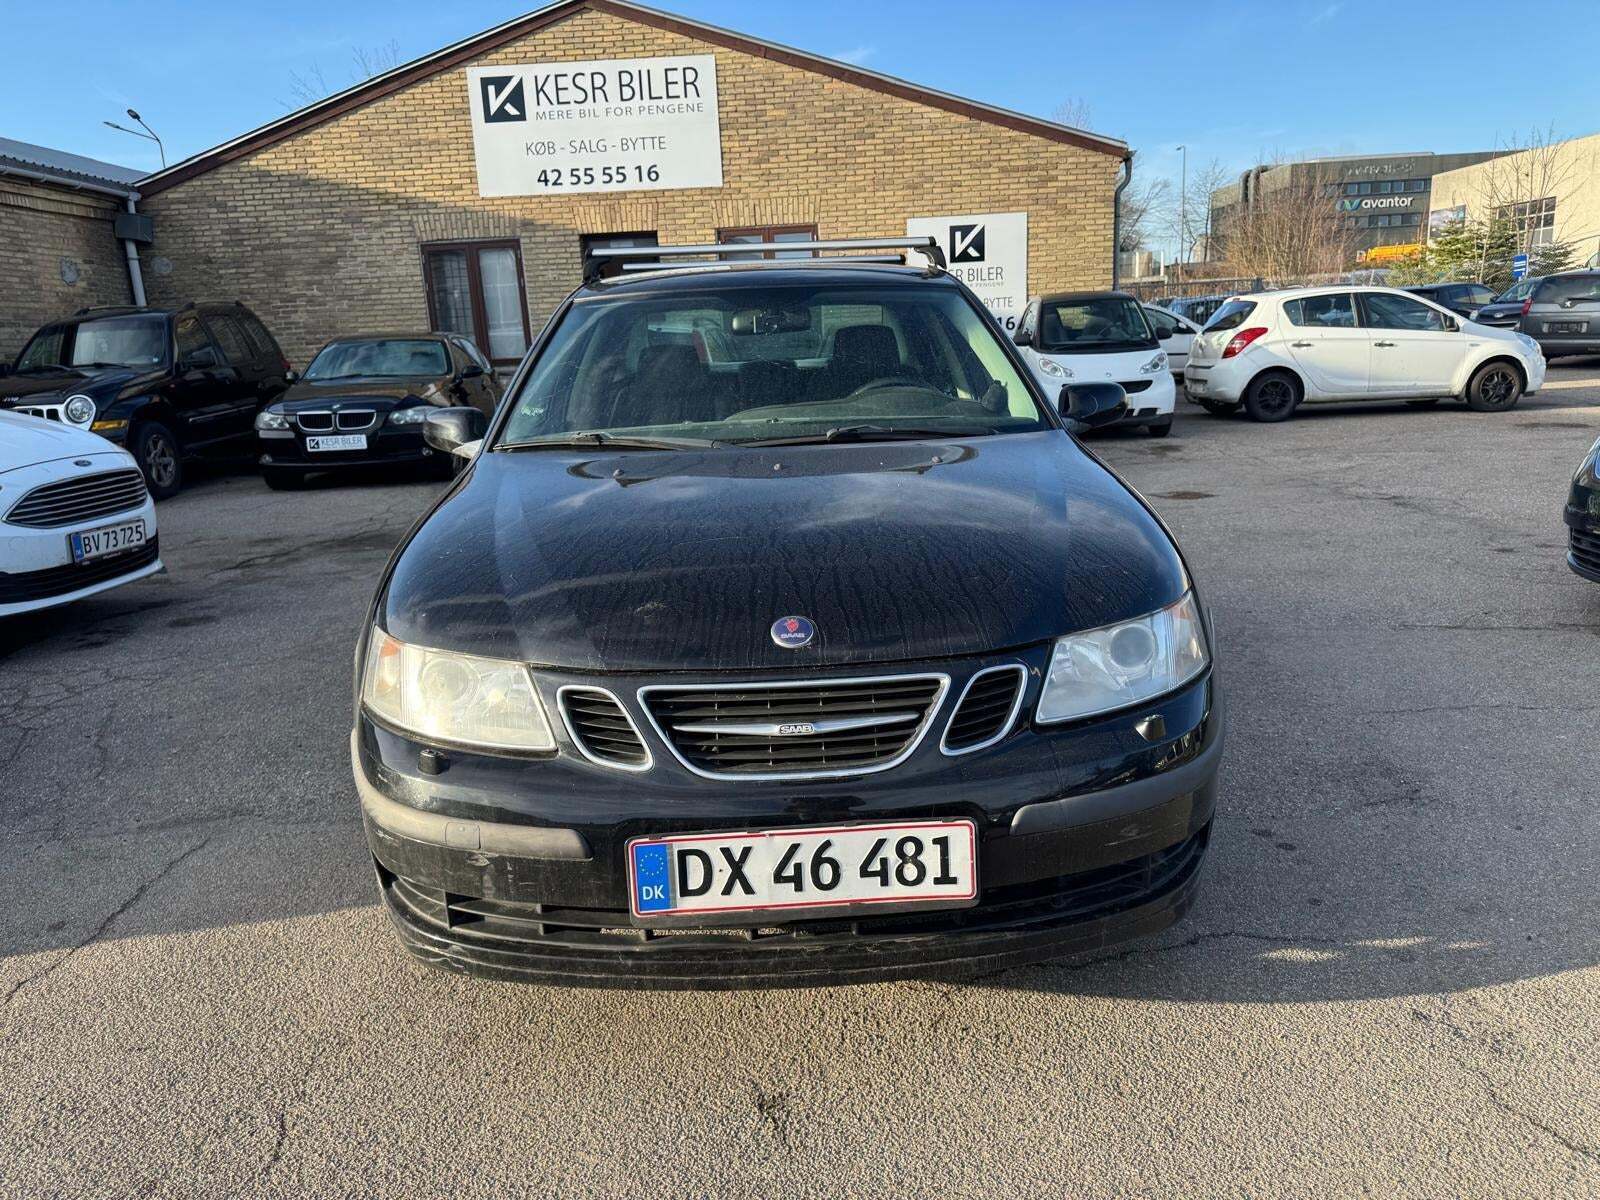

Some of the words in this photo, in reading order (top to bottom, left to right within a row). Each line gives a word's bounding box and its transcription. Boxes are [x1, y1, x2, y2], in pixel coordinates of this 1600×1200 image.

[534, 71, 609, 106] KESR
[618, 66, 701, 102] BILER
[535, 109, 573, 121] MERE
[579, 108, 600, 119] BIL
[605, 106, 633, 117] FOR
[639, 102, 704, 115] PENGENE
[525, 141, 556, 156] KØB
[569, 138, 607, 154] SALG
[620, 136, 667, 152] BYTTE
[537, 169, 563, 187] 42
[570, 167, 595, 185] 55
[602, 166, 627, 184] 55
[634, 164, 660, 182] 16
[1361, 196, 1414, 208] avantor
[967, 266, 1004, 282] BILER
[83, 534, 100, 554] BV
[103, 530, 119, 549] 73
[120, 525, 143, 544] 725
[780, 725, 813, 734] SAAB
[677, 846, 755, 898] DX
[773, 839, 842, 892] 46
[859, 836, 957, 887] 481
[642, 886, 665, 901] DK
